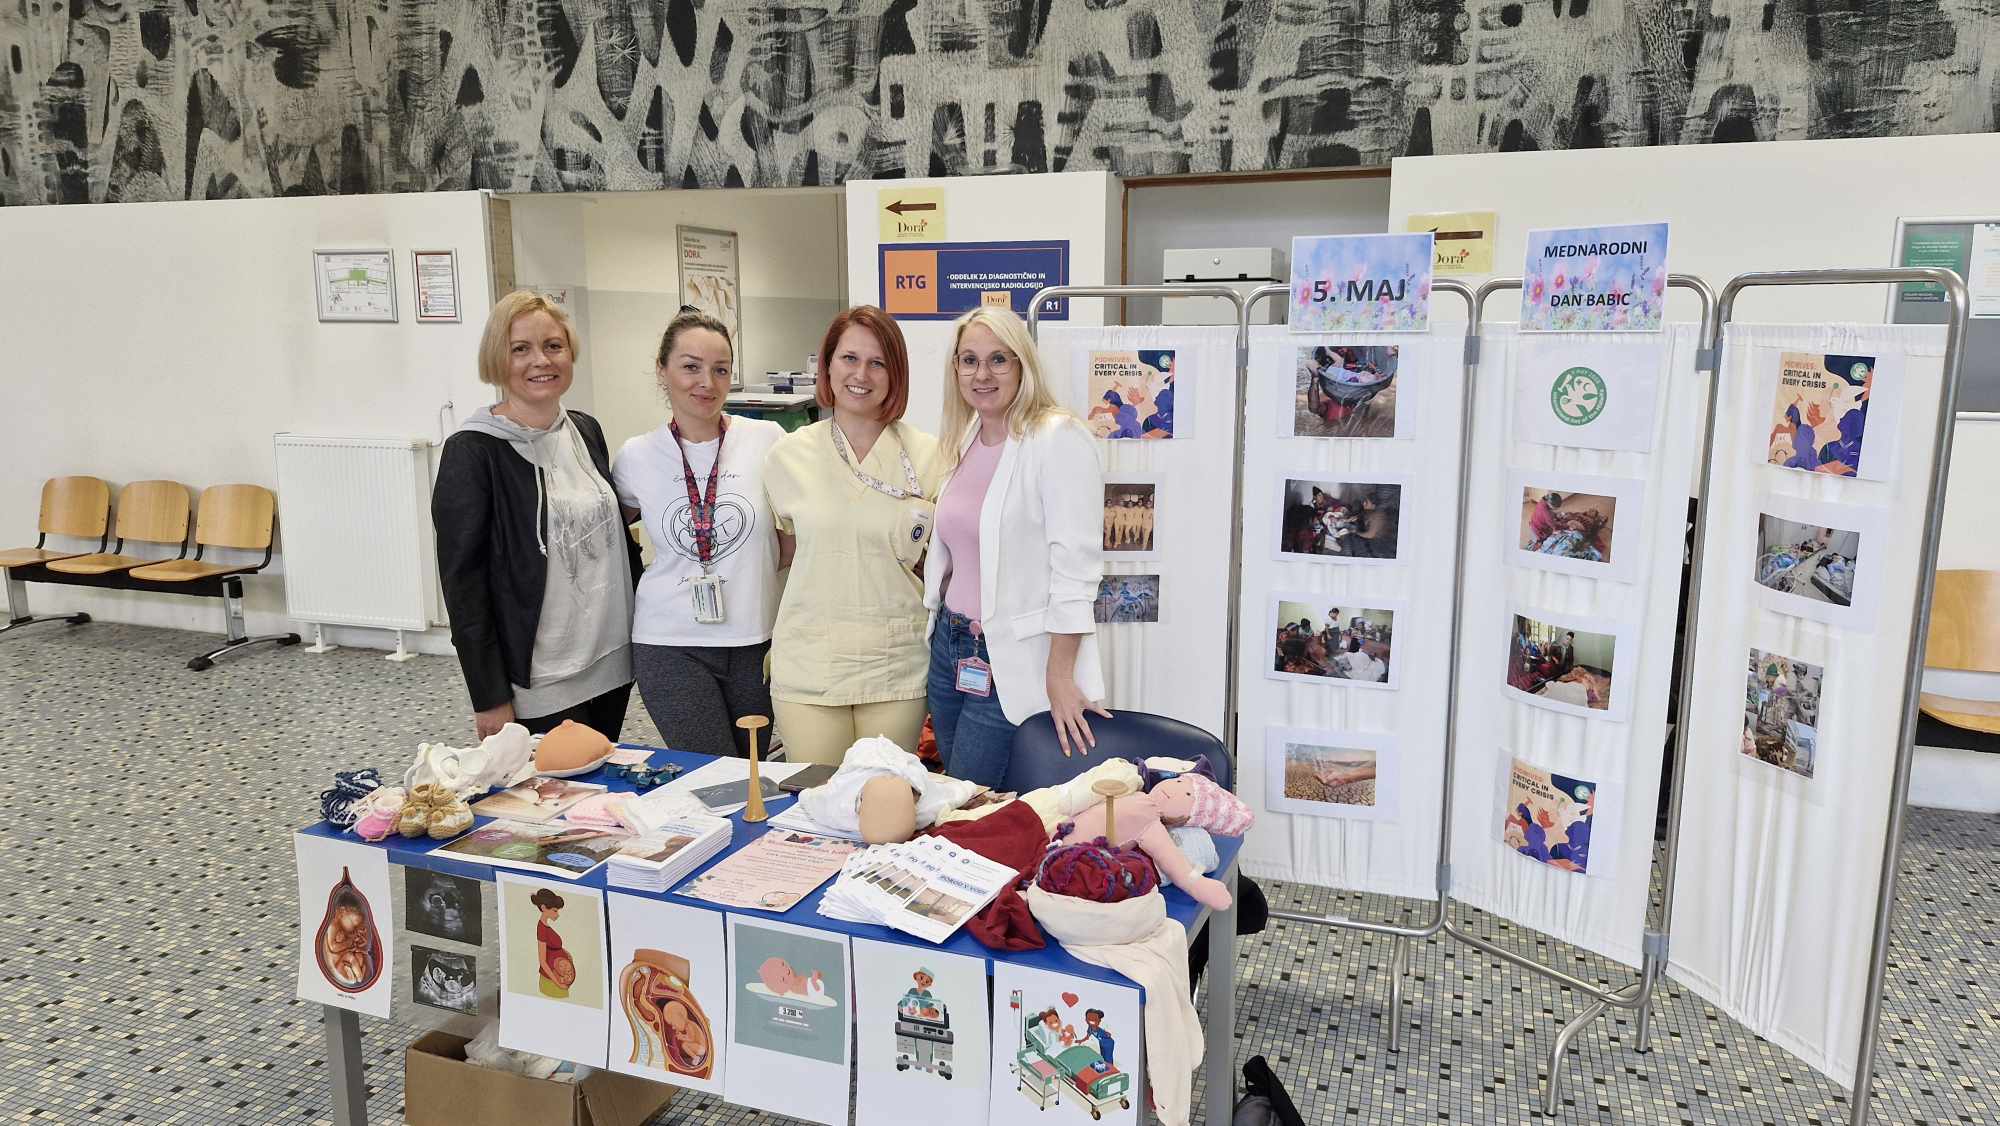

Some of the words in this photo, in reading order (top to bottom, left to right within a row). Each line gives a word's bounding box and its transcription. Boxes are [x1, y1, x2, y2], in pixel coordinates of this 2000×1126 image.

[898, 221, 926, 233] Dora
[1543, 241, 1648, 258] MEDNARODNI
[988, 271, 1037, 280] DIAGNOSTIČNO
[1038, 272, 1046, 280] IN
[895, 275, 927, 290] RTG
[949, 282, 1000, 290] INTERVENCIJSKO
[1001, 282, 1044, 290] RADIOLOGIJO
[1313, 280, 1336, 303] 5.
[1346, 278, 1406, 302] MAJ
[1046, 301, 1059, 311] R1
[1550, 294, 1582, 307] DAN
[1586, 293, 1631, 307] BABIC
[1784, 369, 1811, 378] CRITICAL
[1813, 371, 1821, 379] IN
[1782, 378, 1800, 386] EVERY
[1802, 380, 1826, 388] CRISIS
[1513, 772, 1540, 788] CRITICAL
[1541, 783, 1549, 792] IN
[1512, 779, 1530, 791] EVERY
[1531, 788, 1554, 800] CRISIS
